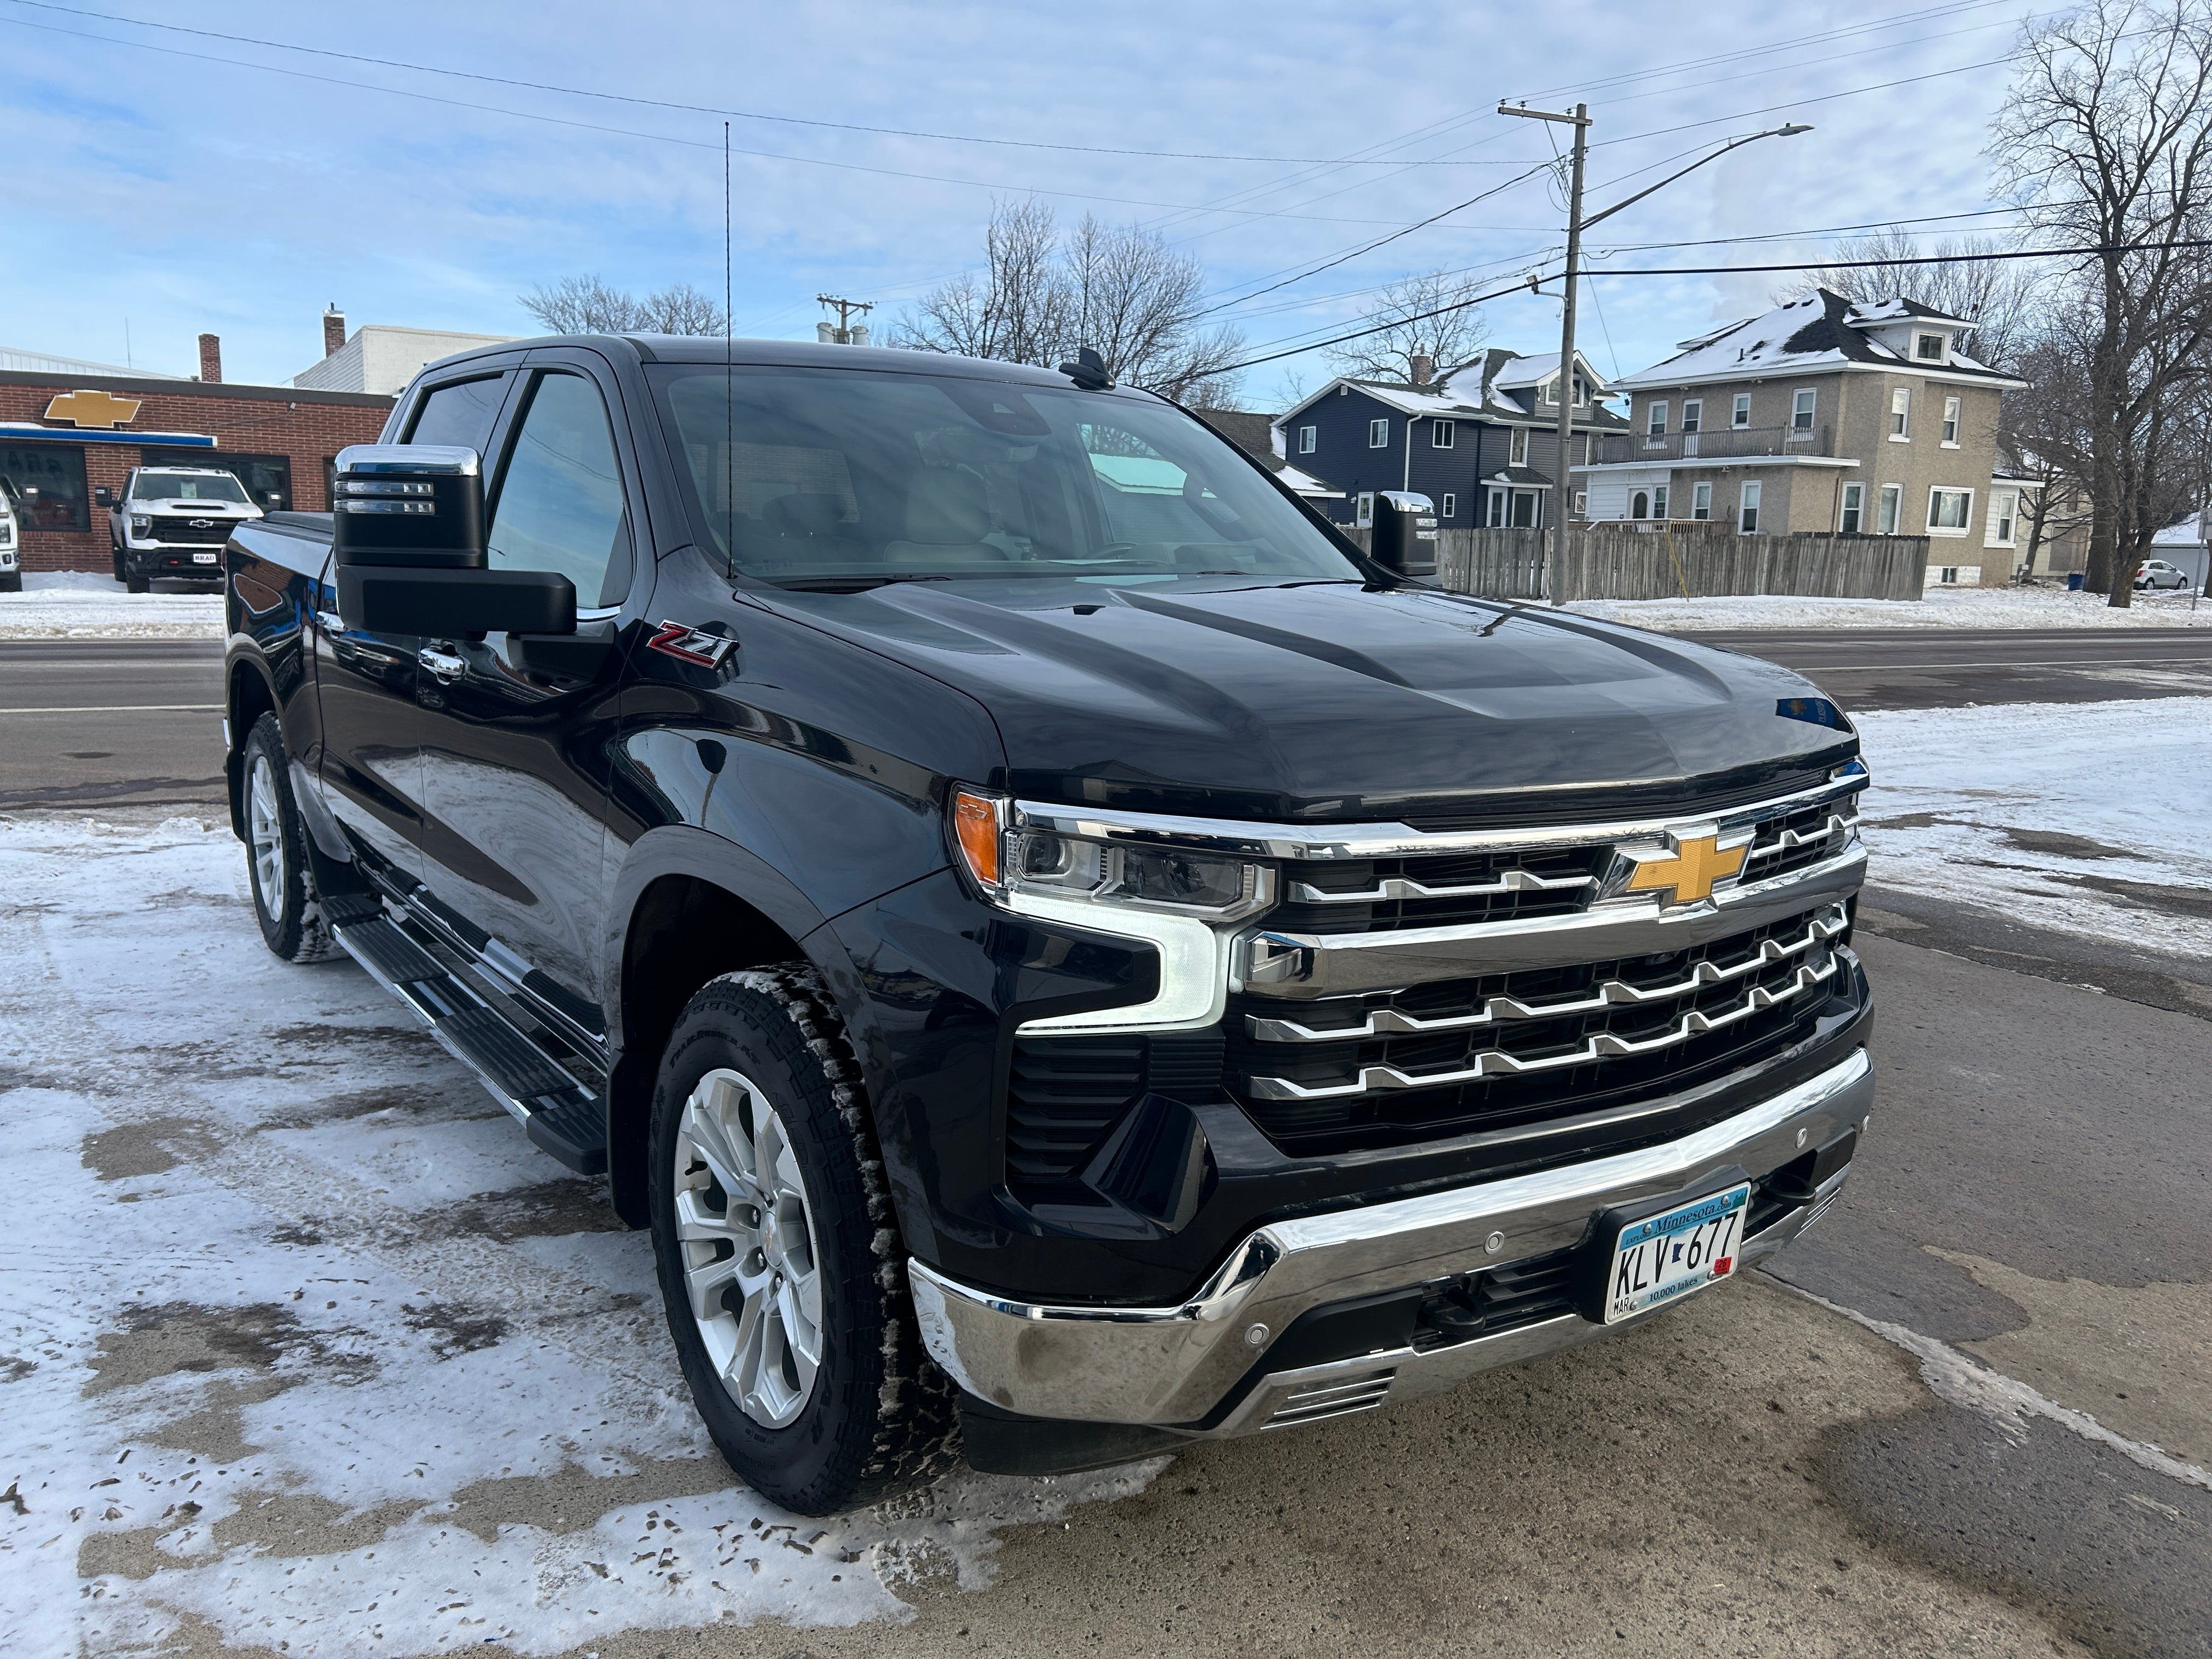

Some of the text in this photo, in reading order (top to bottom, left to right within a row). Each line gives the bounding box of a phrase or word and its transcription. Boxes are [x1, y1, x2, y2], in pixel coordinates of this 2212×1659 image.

[646, 619, 740, 669] Z71
[1626, 1201, 1731, 1245] EXPLORE Minnesota.com
[1615, 1211, 1739, 1299] KLV 677
[1613, 1297, 1629, 1316] MAR
[1650, 1277, 1698, 1302] 10,000 lakes
